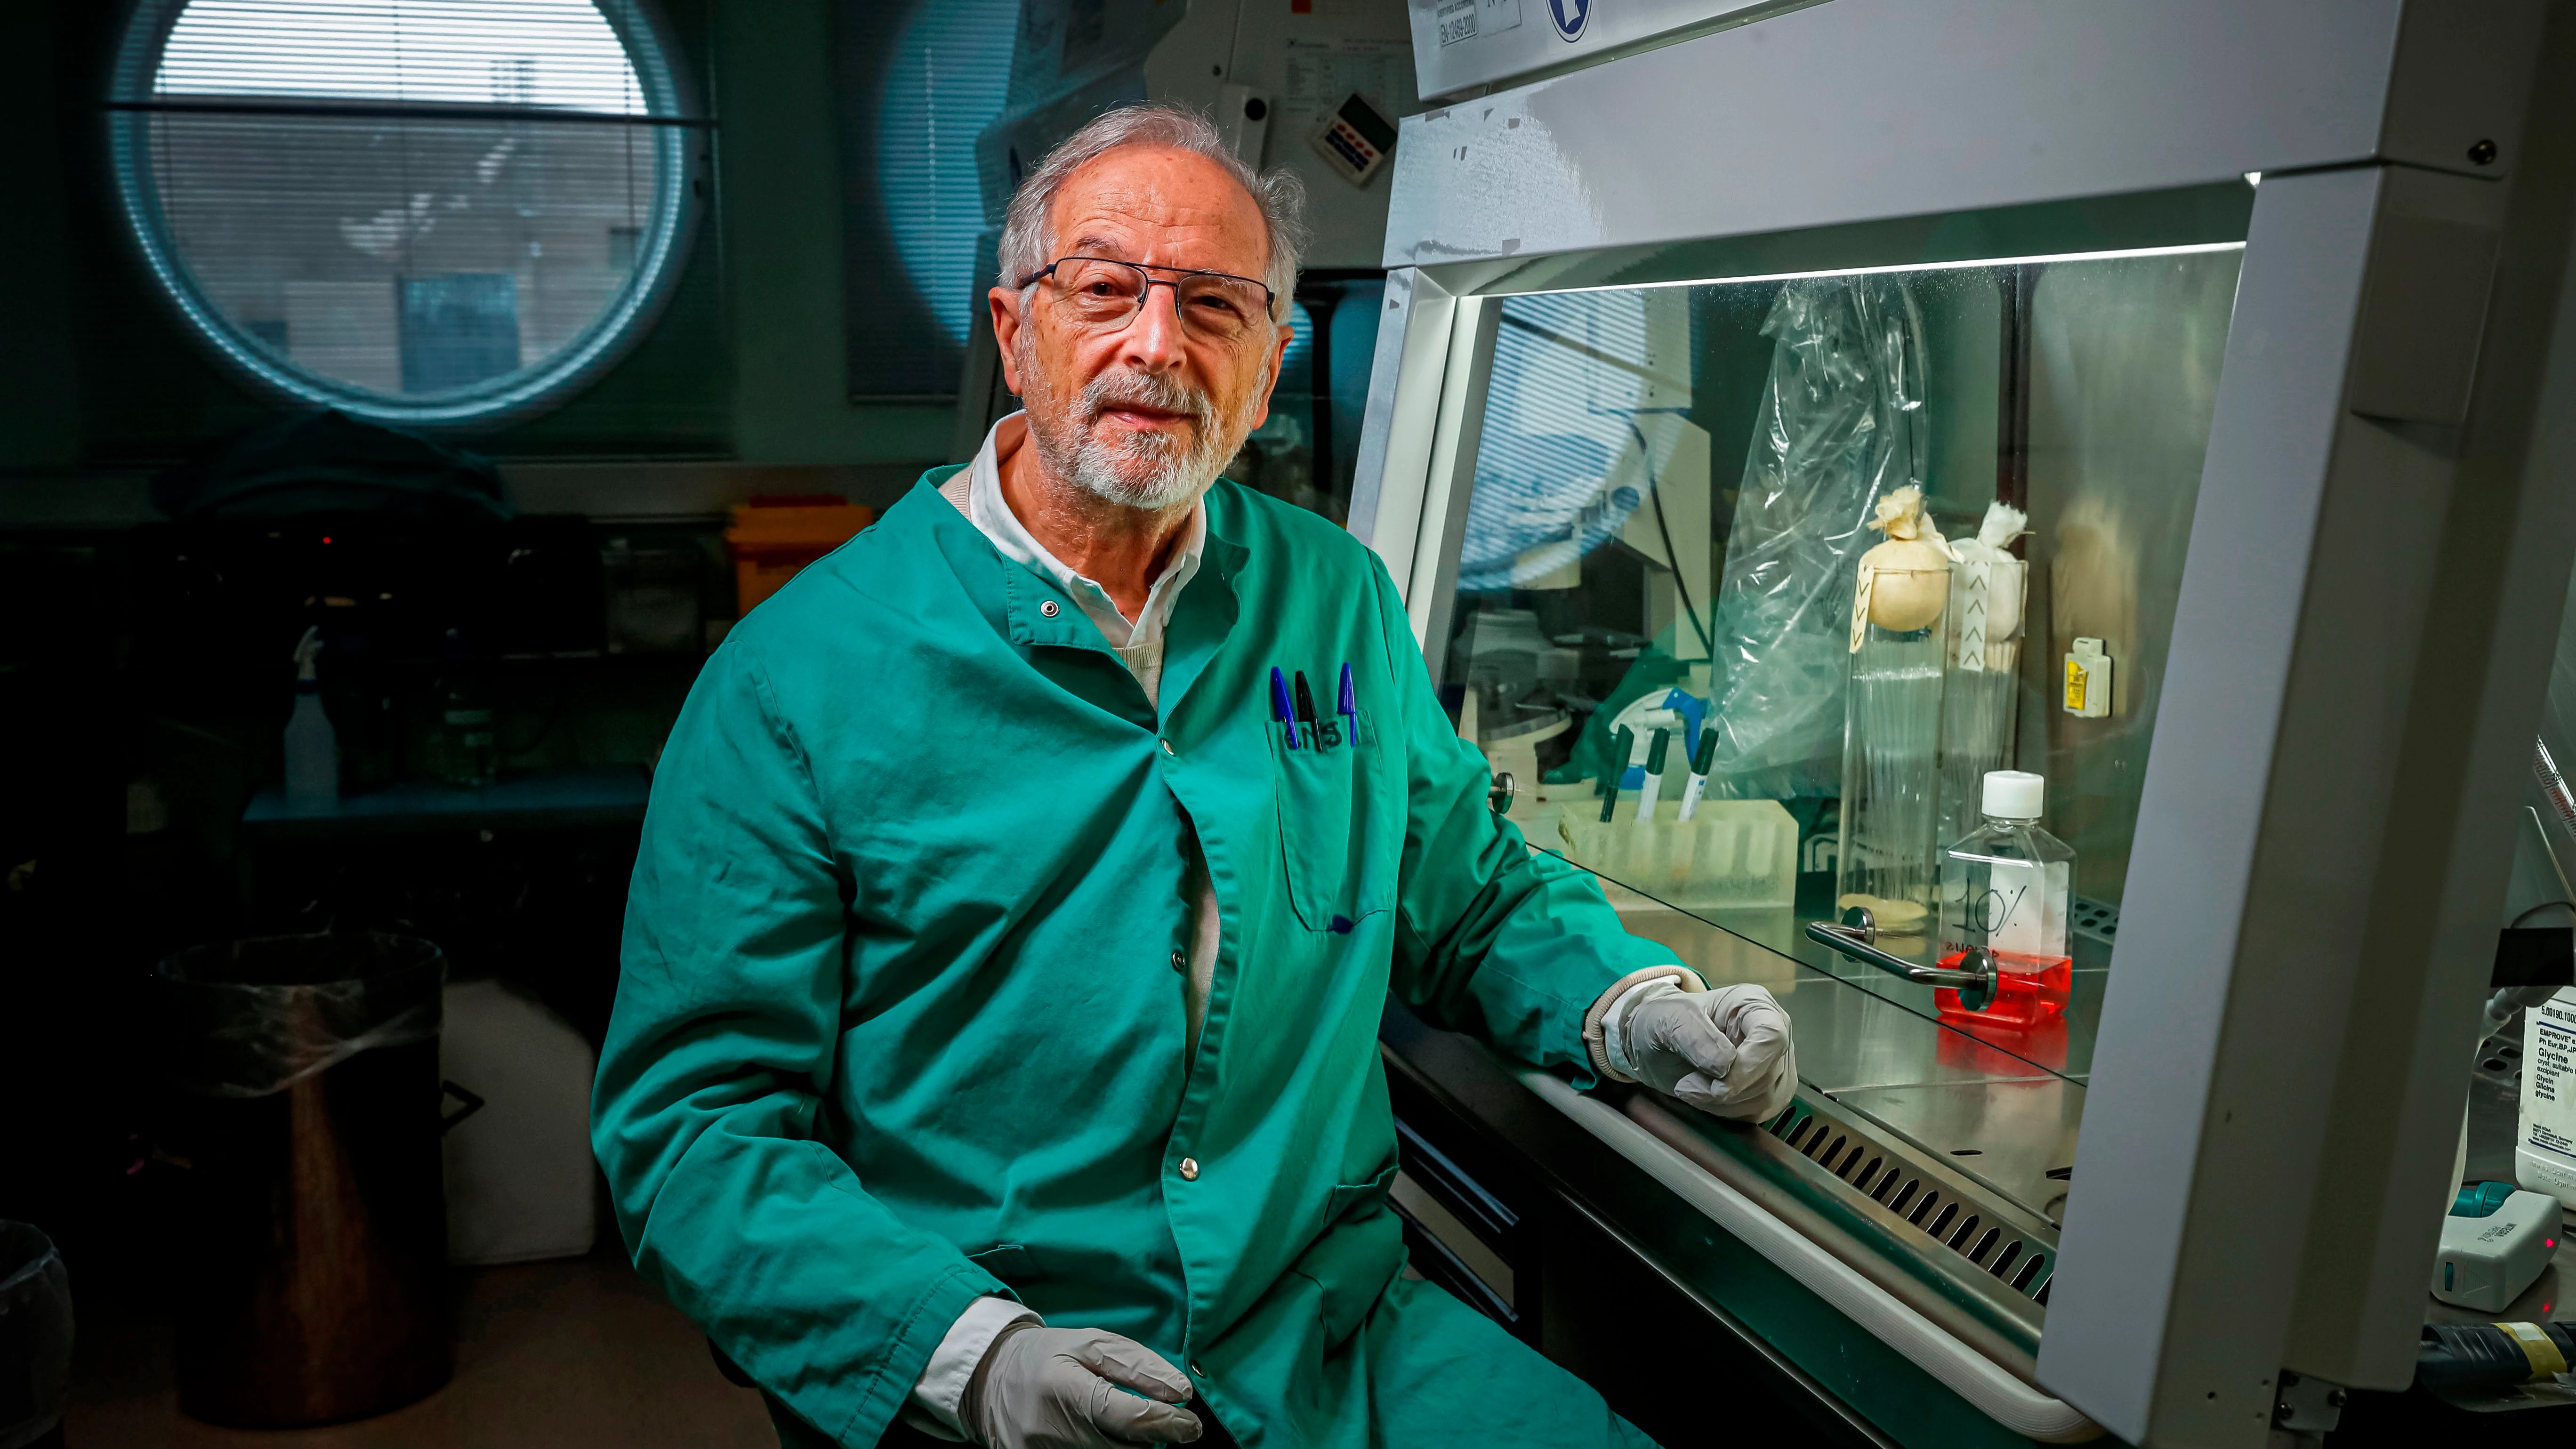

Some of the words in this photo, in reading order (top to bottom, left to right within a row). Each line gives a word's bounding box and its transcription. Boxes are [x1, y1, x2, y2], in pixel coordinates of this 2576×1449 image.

[1952, 878, 2027, 937] 10%
[2539, 1037, 2546, 1045] Ph
[2539, 1047, 2568, 1064] Glycine
[2536, 1074, 2554, 1085] Glycin
